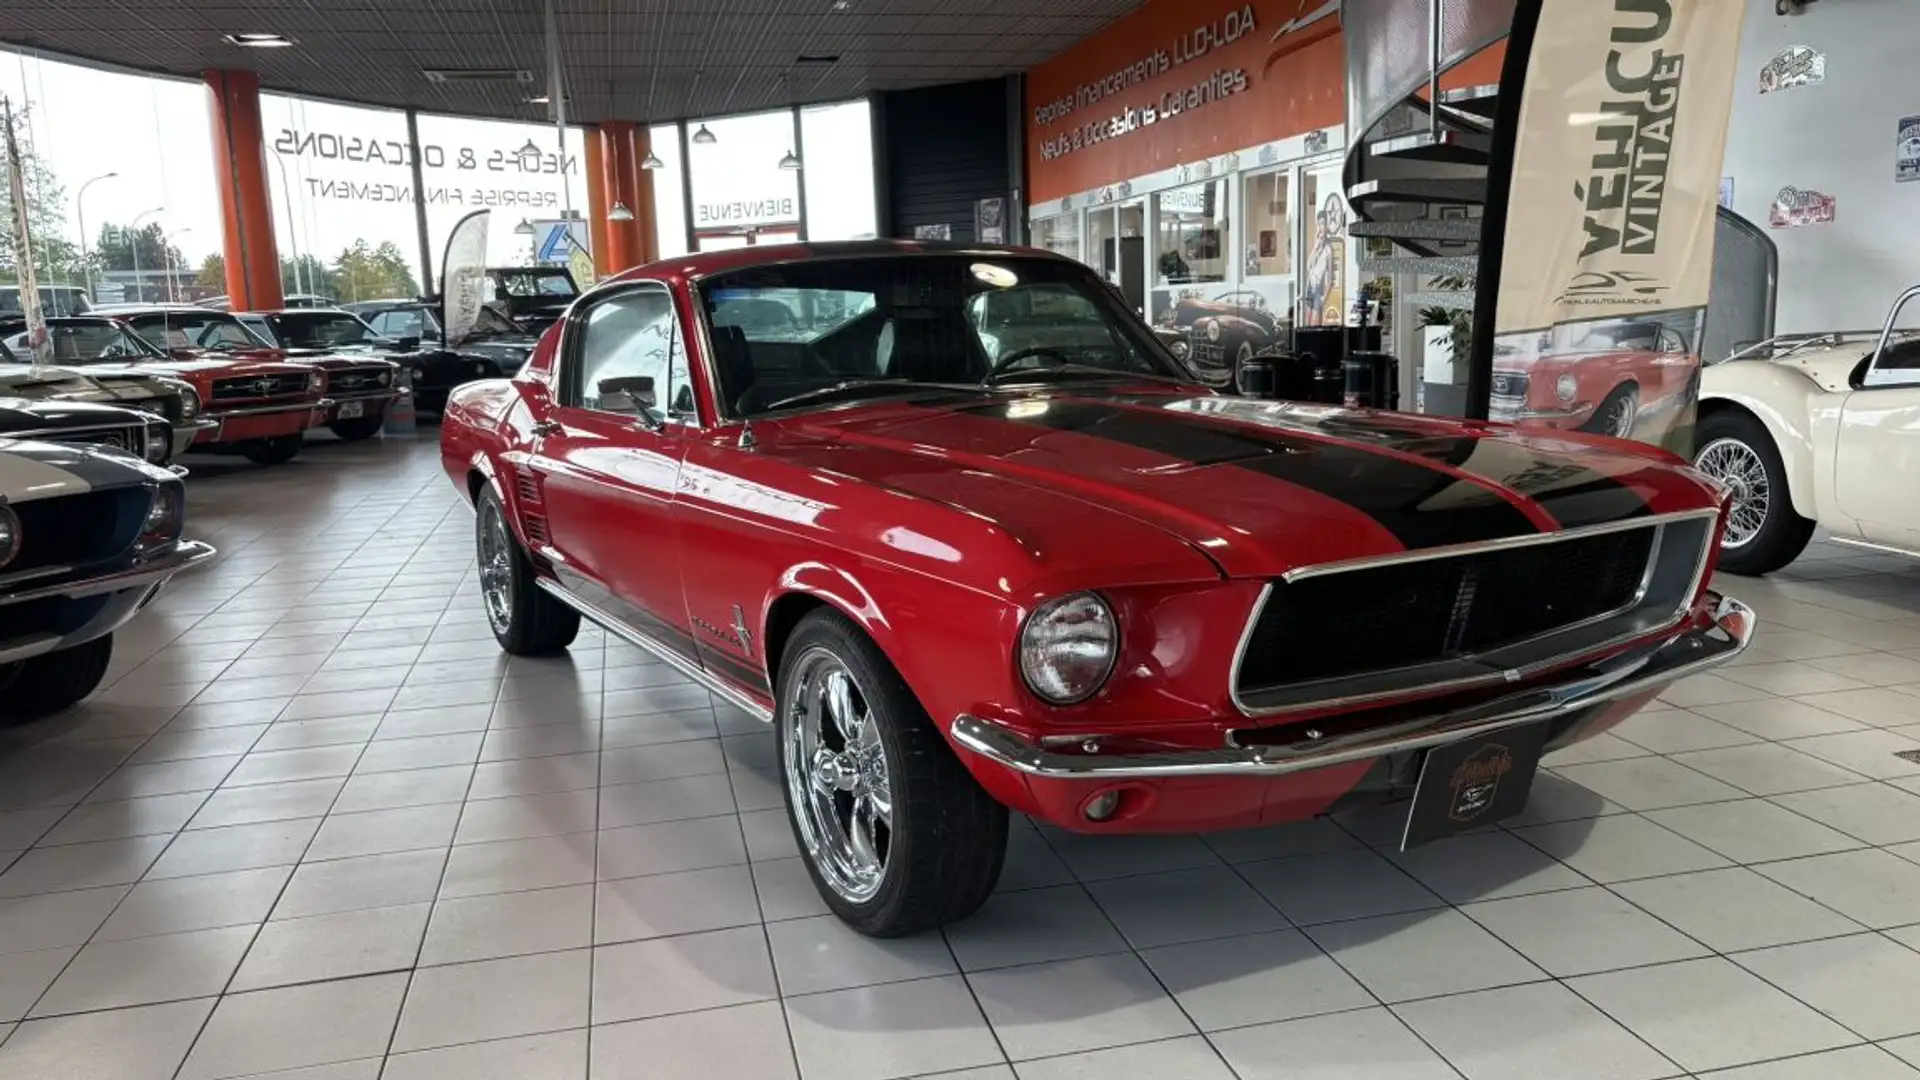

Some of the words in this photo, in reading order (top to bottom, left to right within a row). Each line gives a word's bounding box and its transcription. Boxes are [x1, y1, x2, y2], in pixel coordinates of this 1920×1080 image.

[1034, 93, 1073, 127] Reprise
[1075, 47, 1170, 110] financements
[1173, 3, 1255, 66] LLD-LOA
[1039, 132, 1071, 162] Neufs
[1072, 127, 1084, 149] &
[1084, 104, 1157, 146] Occasions
[1159, 67, 1247, 121] Garanties
[1624, 58, 1682, 249] VINTAGE
